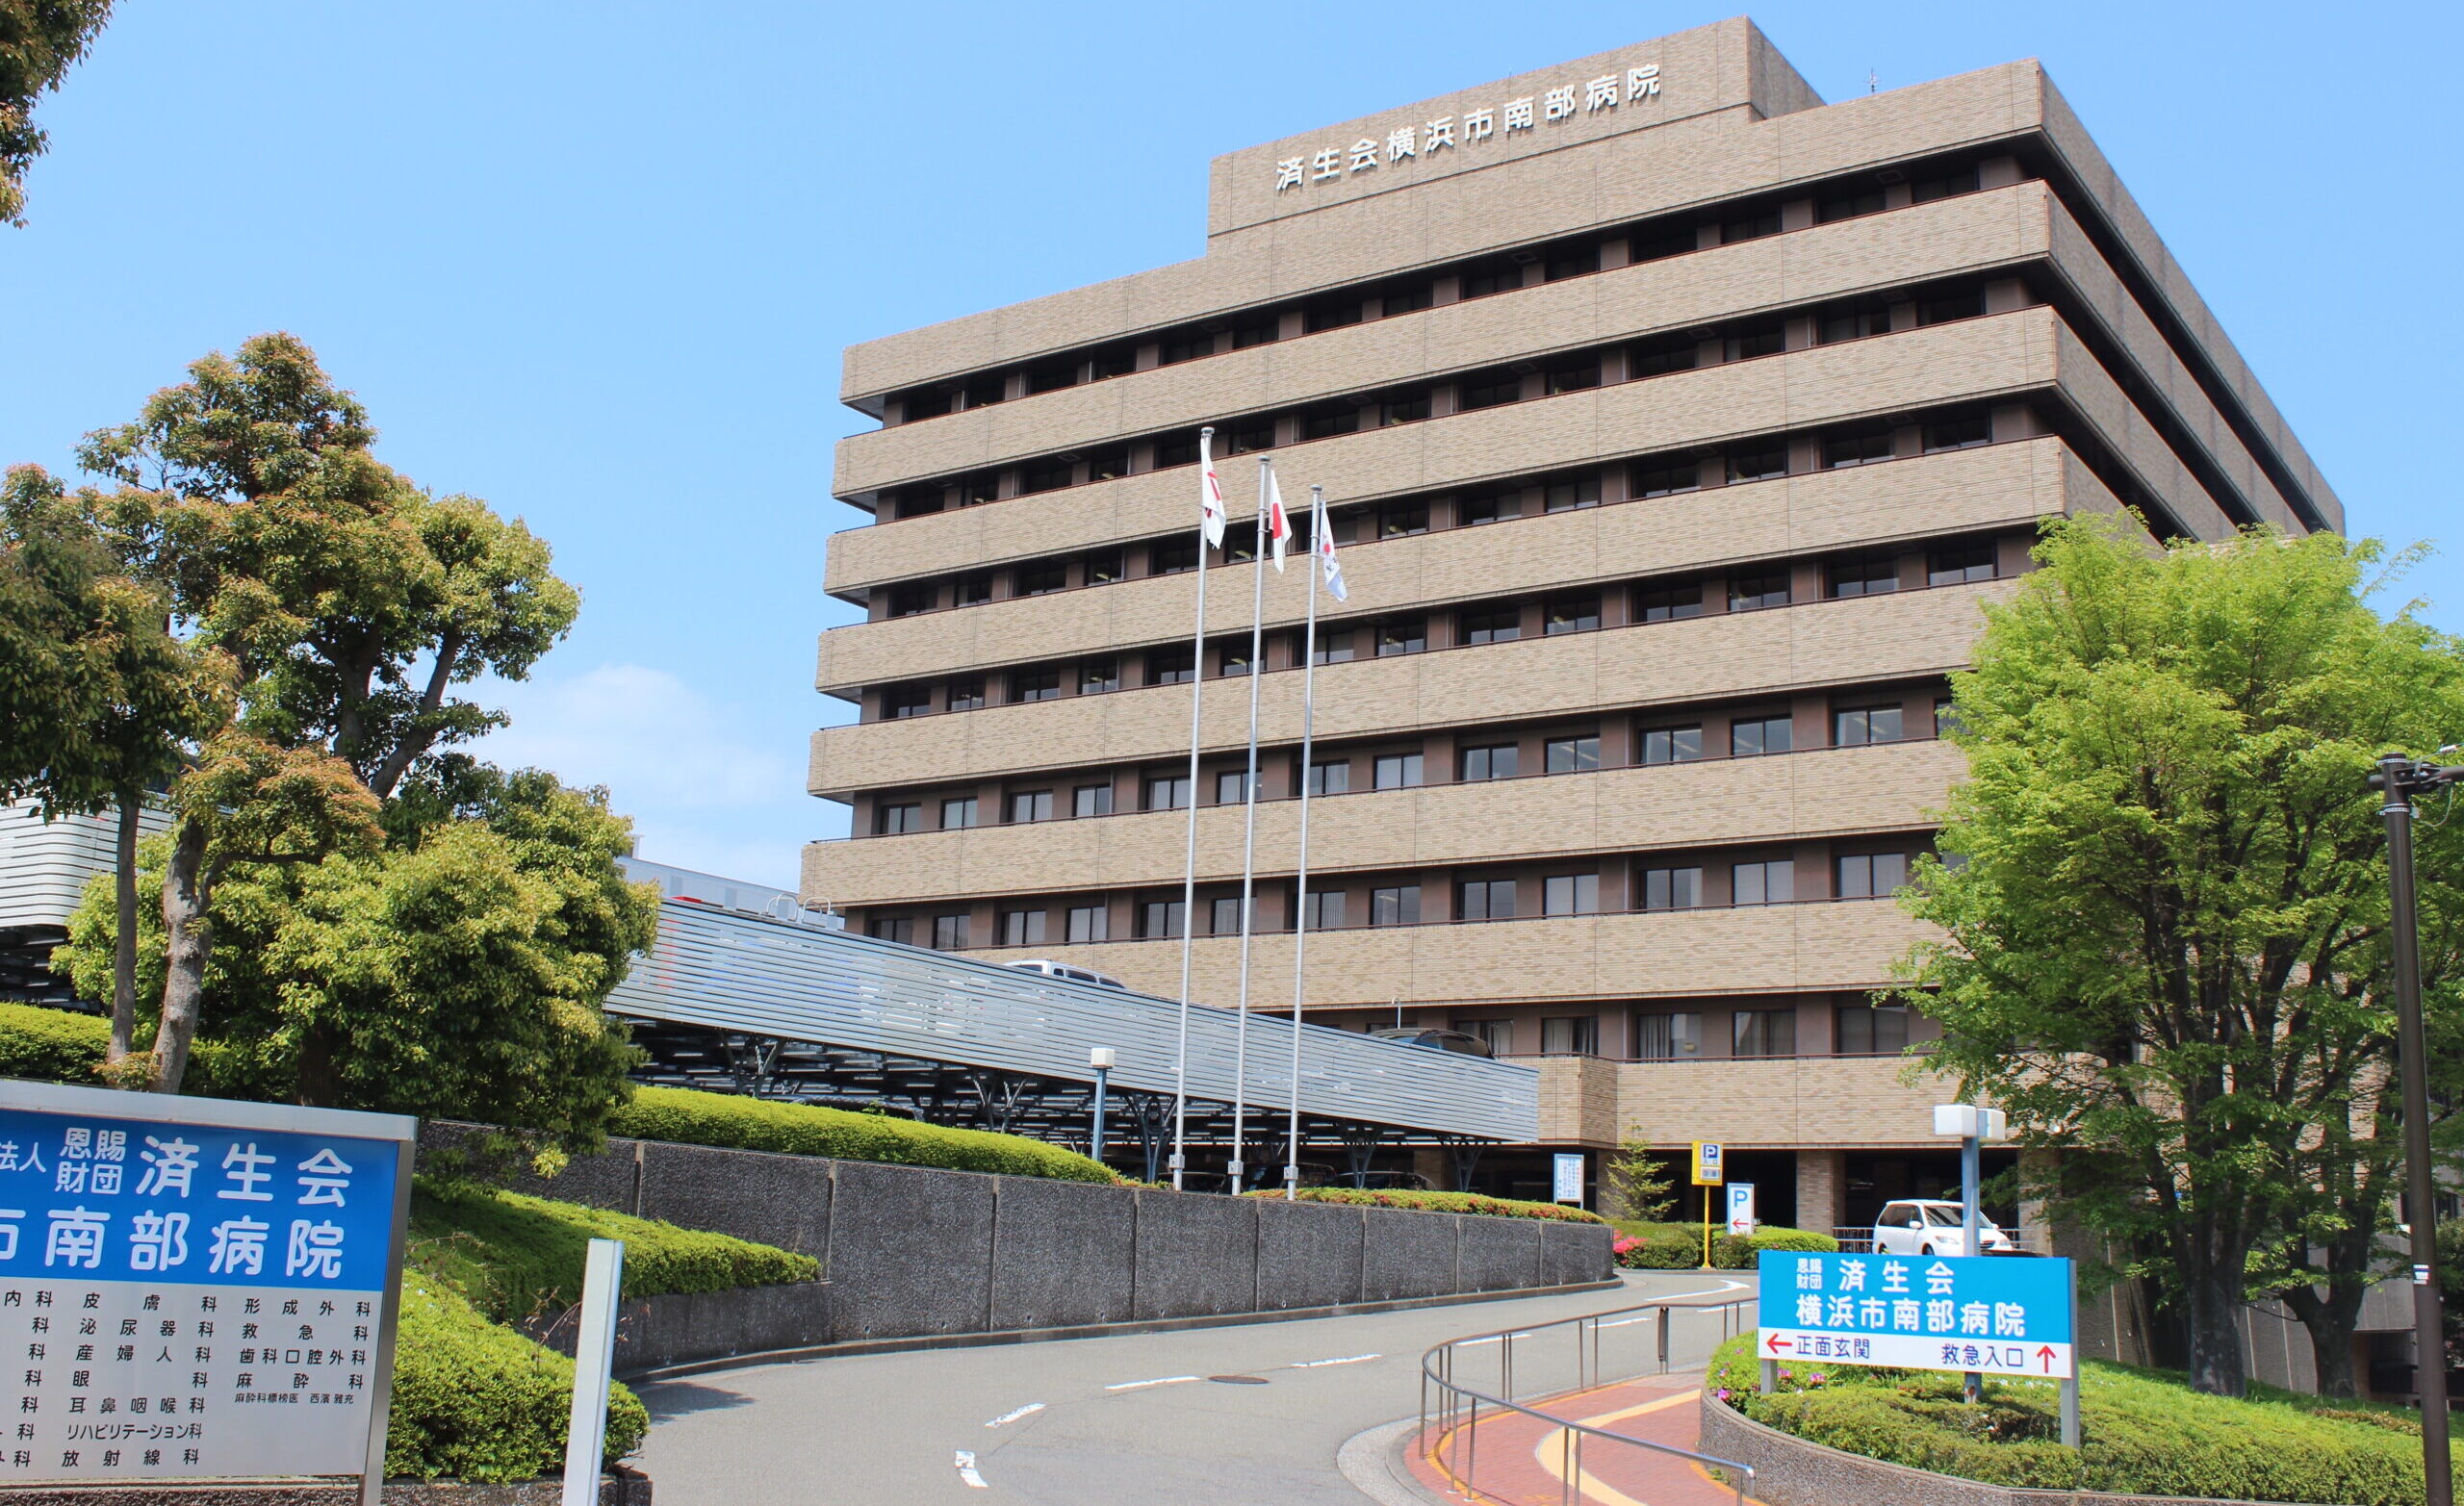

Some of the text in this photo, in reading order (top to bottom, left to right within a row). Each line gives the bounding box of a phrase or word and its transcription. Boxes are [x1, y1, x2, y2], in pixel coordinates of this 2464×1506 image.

[1276, 63, 1661, 191] 済生会横浜市南部病院
[60, 1127, 127, 1161] 恩賜
[1704, 1145, 1717, 1158] P
[54, 1161, 123, 1195] 財団
[135, 1135, 353, 1208] 済生会
[1733, 1189, 1748, 1208] P
[1838, 1259, 1955, 1295] 済生会
[83, 1291, 217, 1313] 皮膚科
[244, 1297, 371, 1317] 形成外科
[1795, 1292, 2026, 1338] 横浜市南部病院
[79, 1317, 215, 1338] 泌尿器科
[242, 1322, 369, 1341] 救急科
[75, 1343, 212, 1363] 産婦人科
[240, 1348, 367, 1366] 歯科口腔外科
[1796, 1335, 1870, 1360] 正面玄関
[1940, 1343, 2024, 1367] 救急入口
[72, 1370, 208, 1389] 眼科
[236, 1372, 364, 1390] 麻酔科
[68, 1396, 206, 1415] 耳鼻咽喉科
[67, 1422, 203, 1441] リハビリテーション科
[61, 1448, 200, 1468] 放射線科
